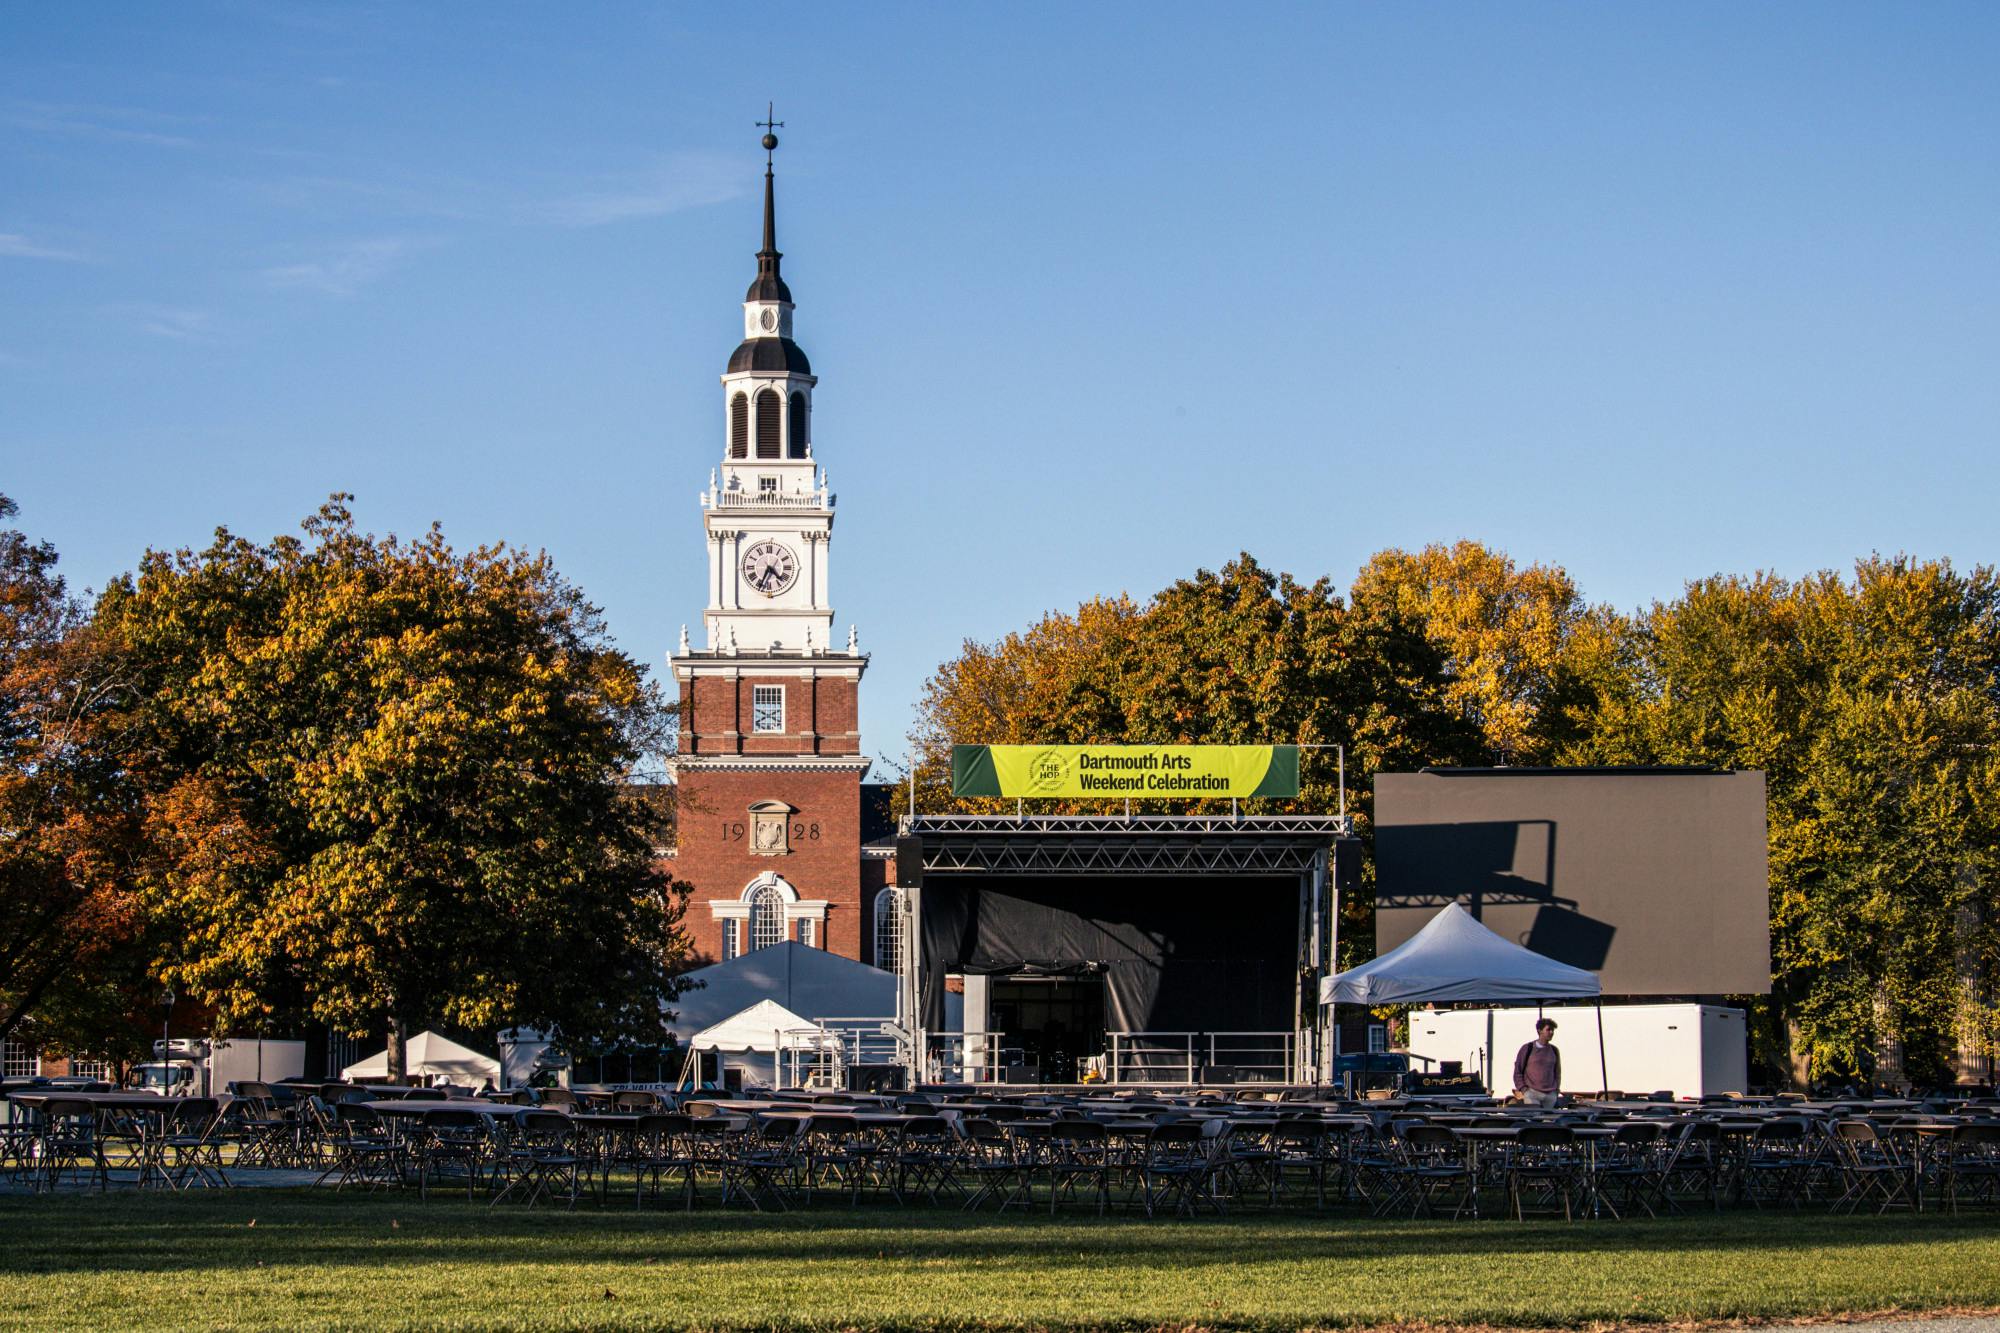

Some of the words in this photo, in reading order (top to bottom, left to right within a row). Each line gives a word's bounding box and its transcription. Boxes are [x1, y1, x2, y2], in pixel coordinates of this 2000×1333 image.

[1080, 753, 1158, 770] Dartmouth
[1161, 753, 1192, 770] Arts
[1080, 773, 1145, 790] Weekend
[1147, 773, 1230, 790] Celebration
